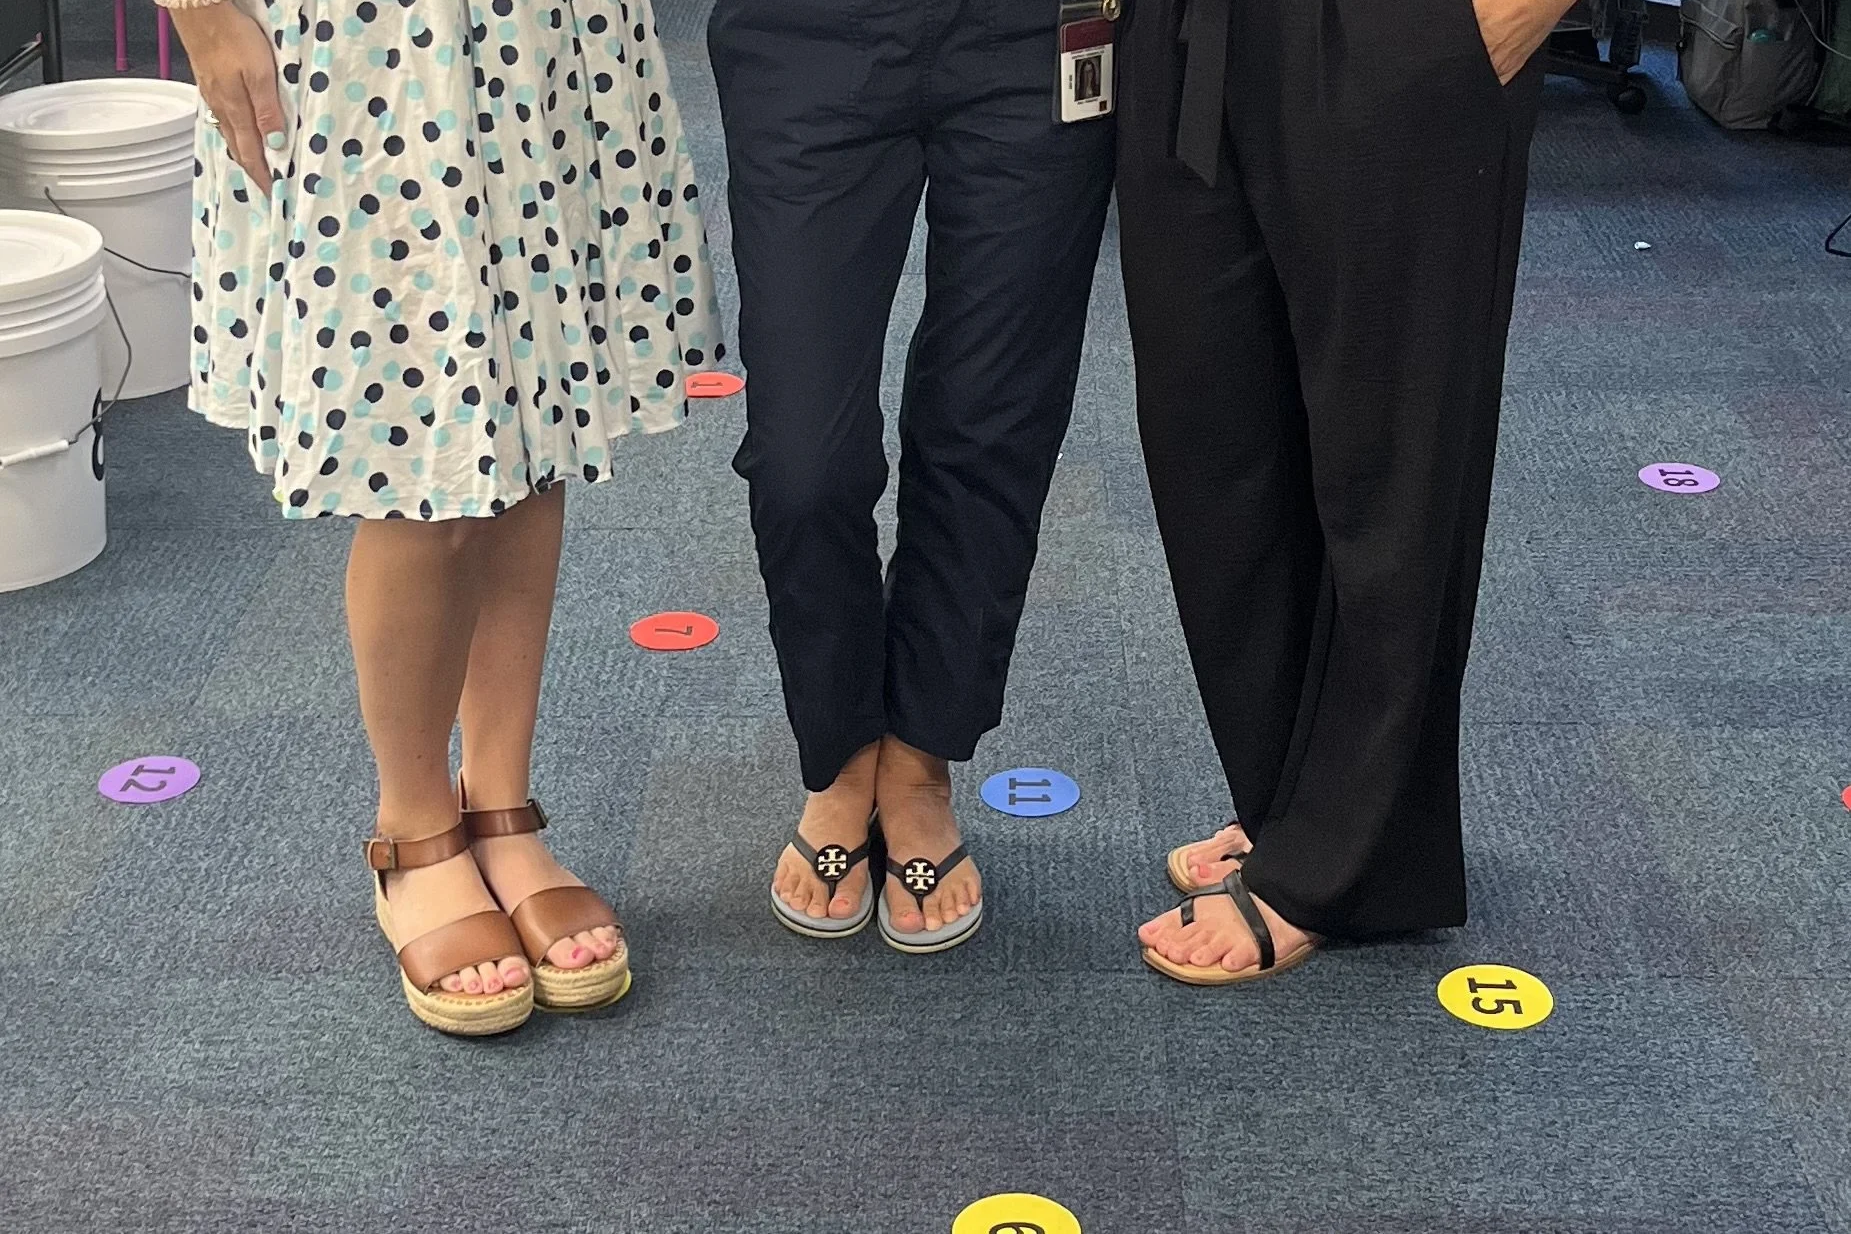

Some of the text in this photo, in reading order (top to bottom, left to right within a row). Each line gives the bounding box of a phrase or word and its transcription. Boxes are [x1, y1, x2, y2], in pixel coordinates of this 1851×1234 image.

[1658, 469, 1699, 486] 18
[119, 765, 176, 792] 12
[1008, 778, 1051, 805] 11
[1467, 977, 1523, 1014] 15
